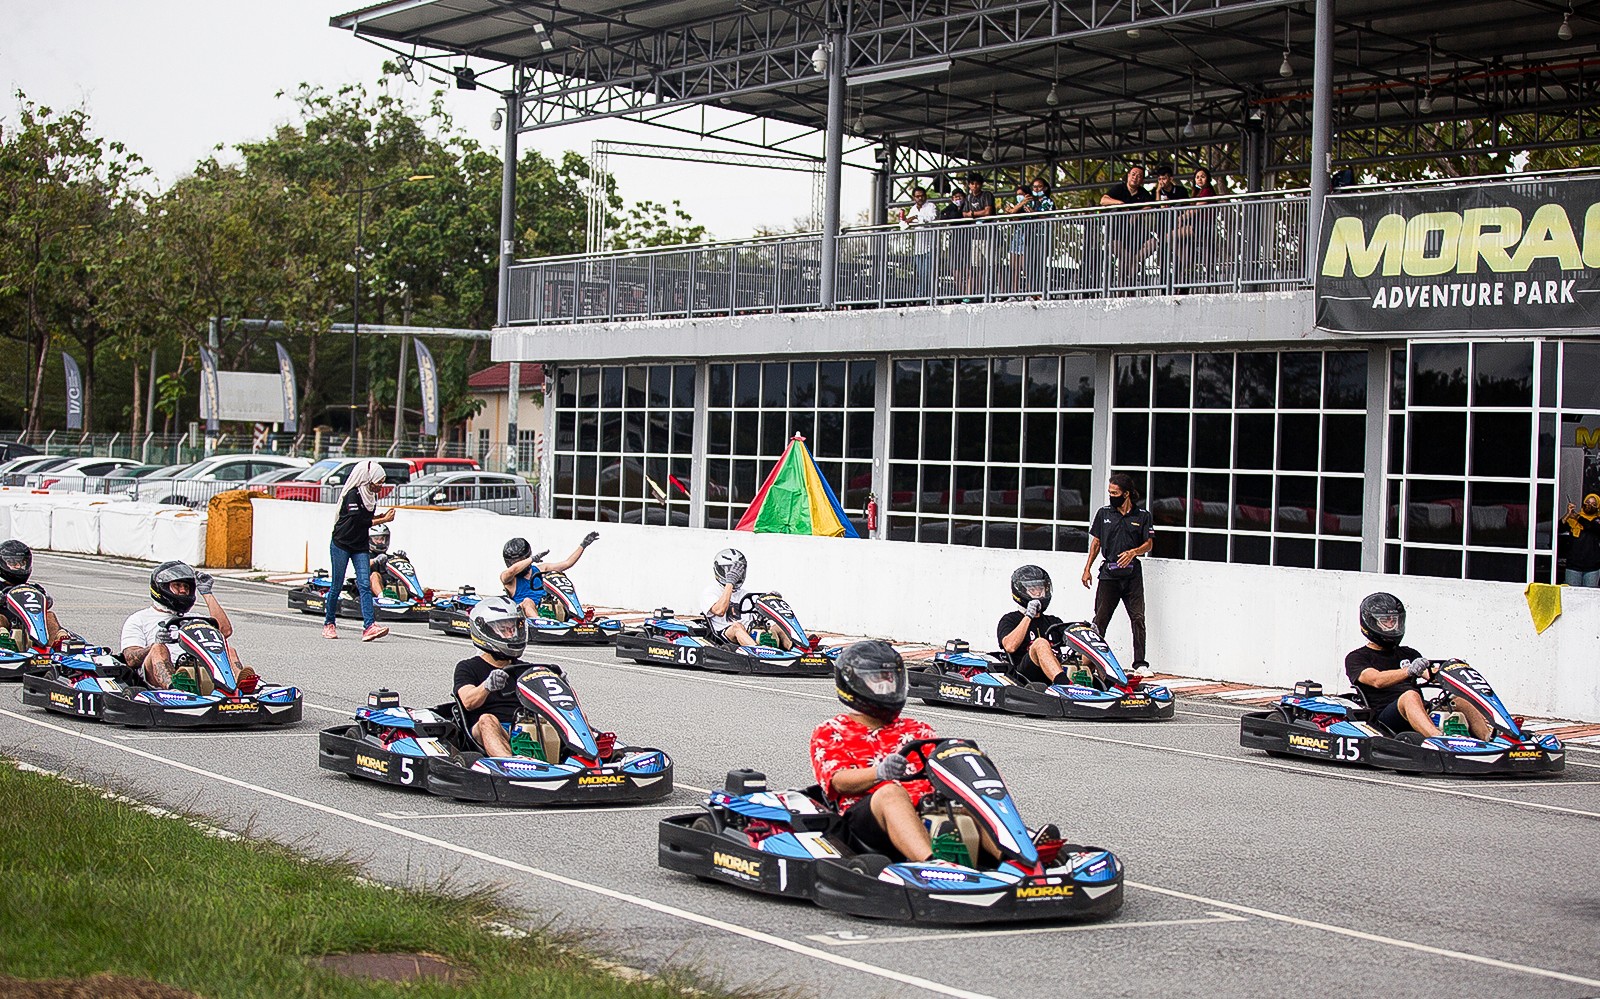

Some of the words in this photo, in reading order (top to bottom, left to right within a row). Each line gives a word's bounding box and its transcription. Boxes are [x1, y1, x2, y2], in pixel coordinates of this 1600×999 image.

[1372, 282, 1504, 309] ADVENTURE
[1514, 279, 1576, 304] PARK
[395, 561, 413, 571] 20
[552, 577, 573, 587] 19
[24, 591, 39, 603] 2
[193, 629, 224, 644] 11
[677, 646, 697, 665] 16
[1459, 668, 1487, 683] 15
[542, 678, 564, 695] 5
[77, 692, 96, 715] 11
[974, 685, 996, 706] 14
[1289, 735, 1329, 749] MORAC
[1335, 736, 1360, 761] 15
[1508, 750, 1543, 758] MORAC
[356, 754, 388, 772] MORAC
[400, 757, 414, 785] 5
[963, 755, 986, 777] 1
[578, 775, 626, 785] MORAC
[713, 851, 760, 877] MORAC
[777, 858, 788, 892] 1
[1016, 885, 1074, 898] MORAC
